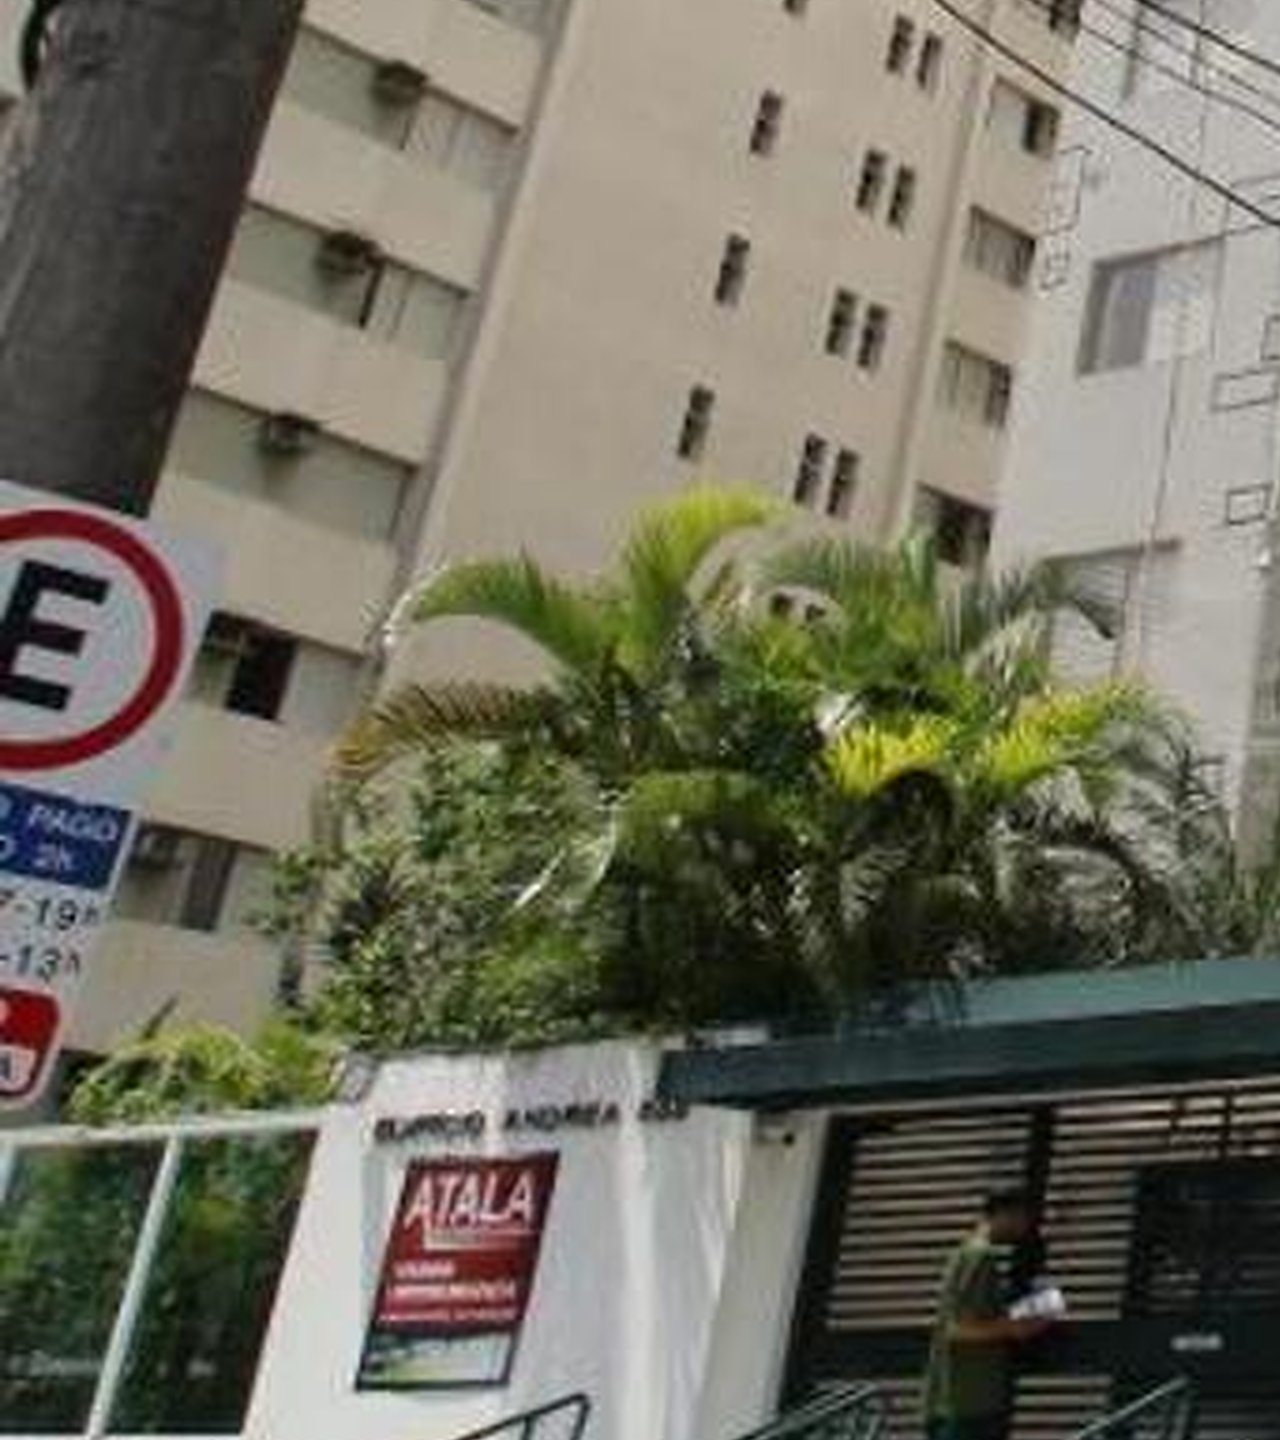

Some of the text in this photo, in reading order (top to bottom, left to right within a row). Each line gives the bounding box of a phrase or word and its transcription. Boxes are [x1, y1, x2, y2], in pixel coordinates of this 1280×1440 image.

[0, 560, 109, 711] E
[28, 803, 119, 842] PAGO
[403, 1170, 534, 1230] ATALA
